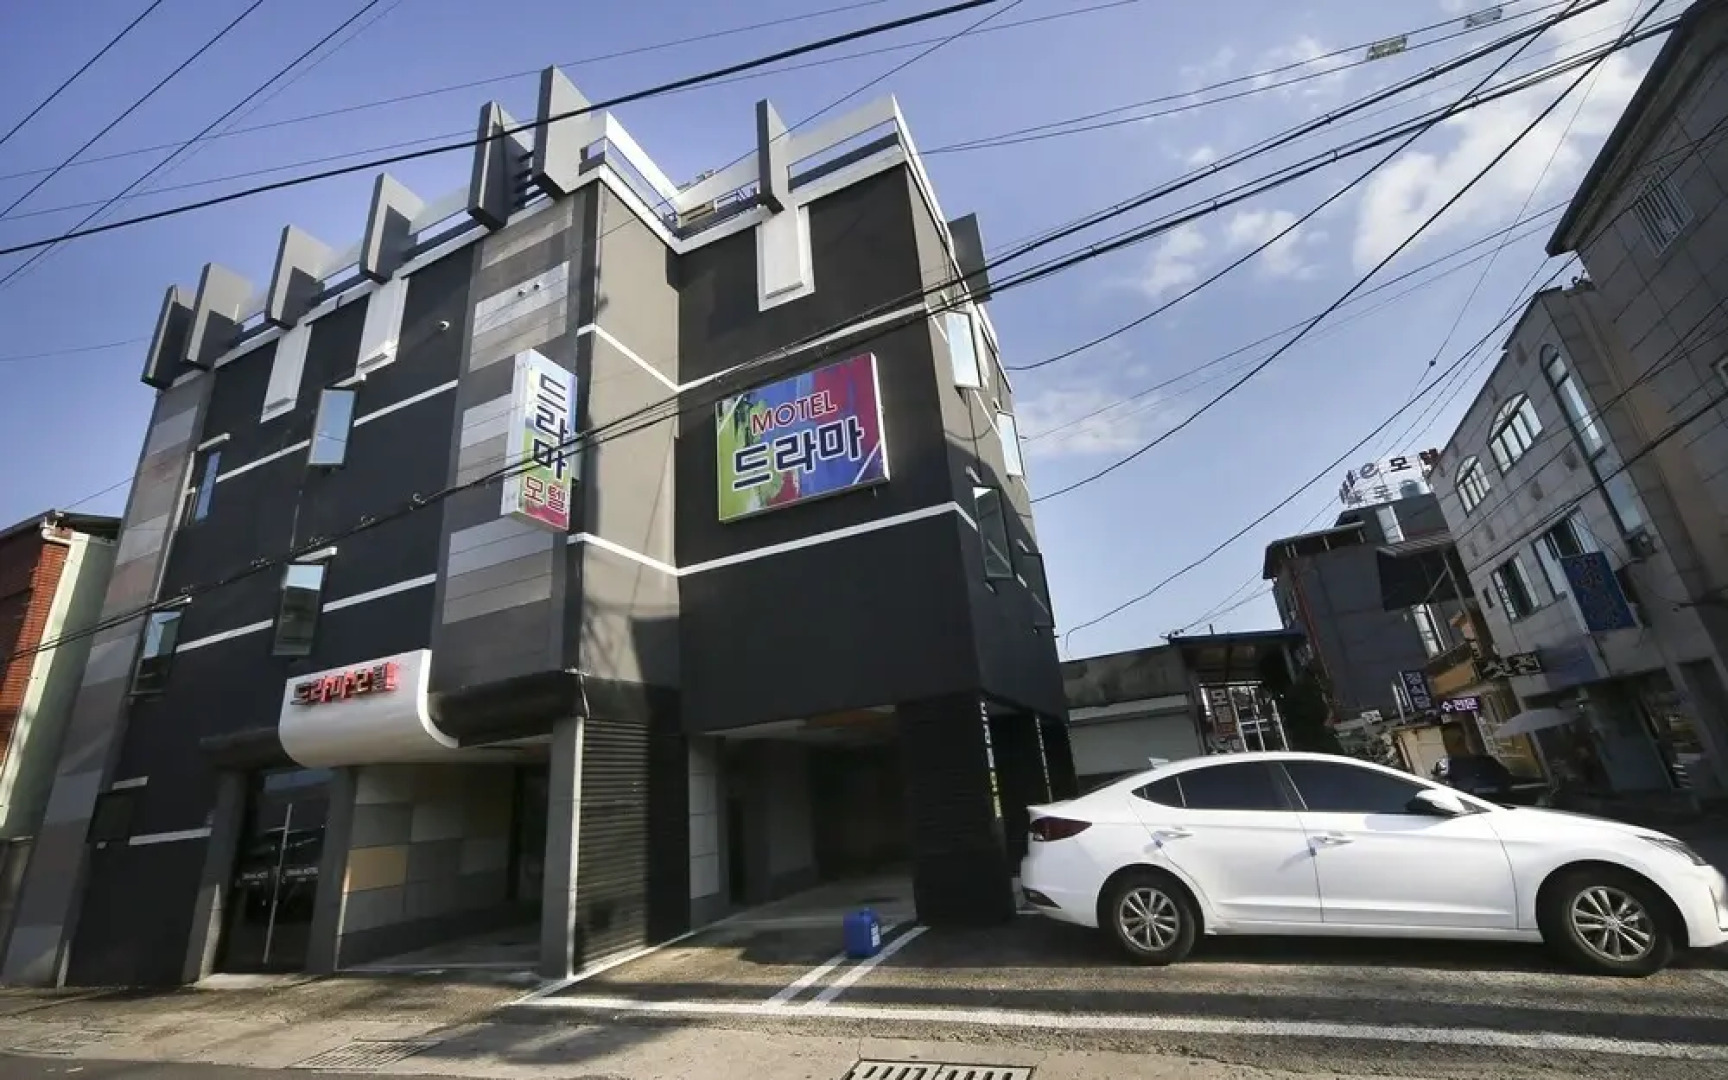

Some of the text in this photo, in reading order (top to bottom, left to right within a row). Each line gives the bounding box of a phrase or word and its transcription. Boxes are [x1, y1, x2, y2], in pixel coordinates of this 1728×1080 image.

[534, 371, 570, 479] 드라마
[750, 391, 837, 435] MOTEL
[733, 416, 865, 491] 드라마
[524, 476, 566, 512] 모텔
[290, 663, 398, 703] 드라마모텔
